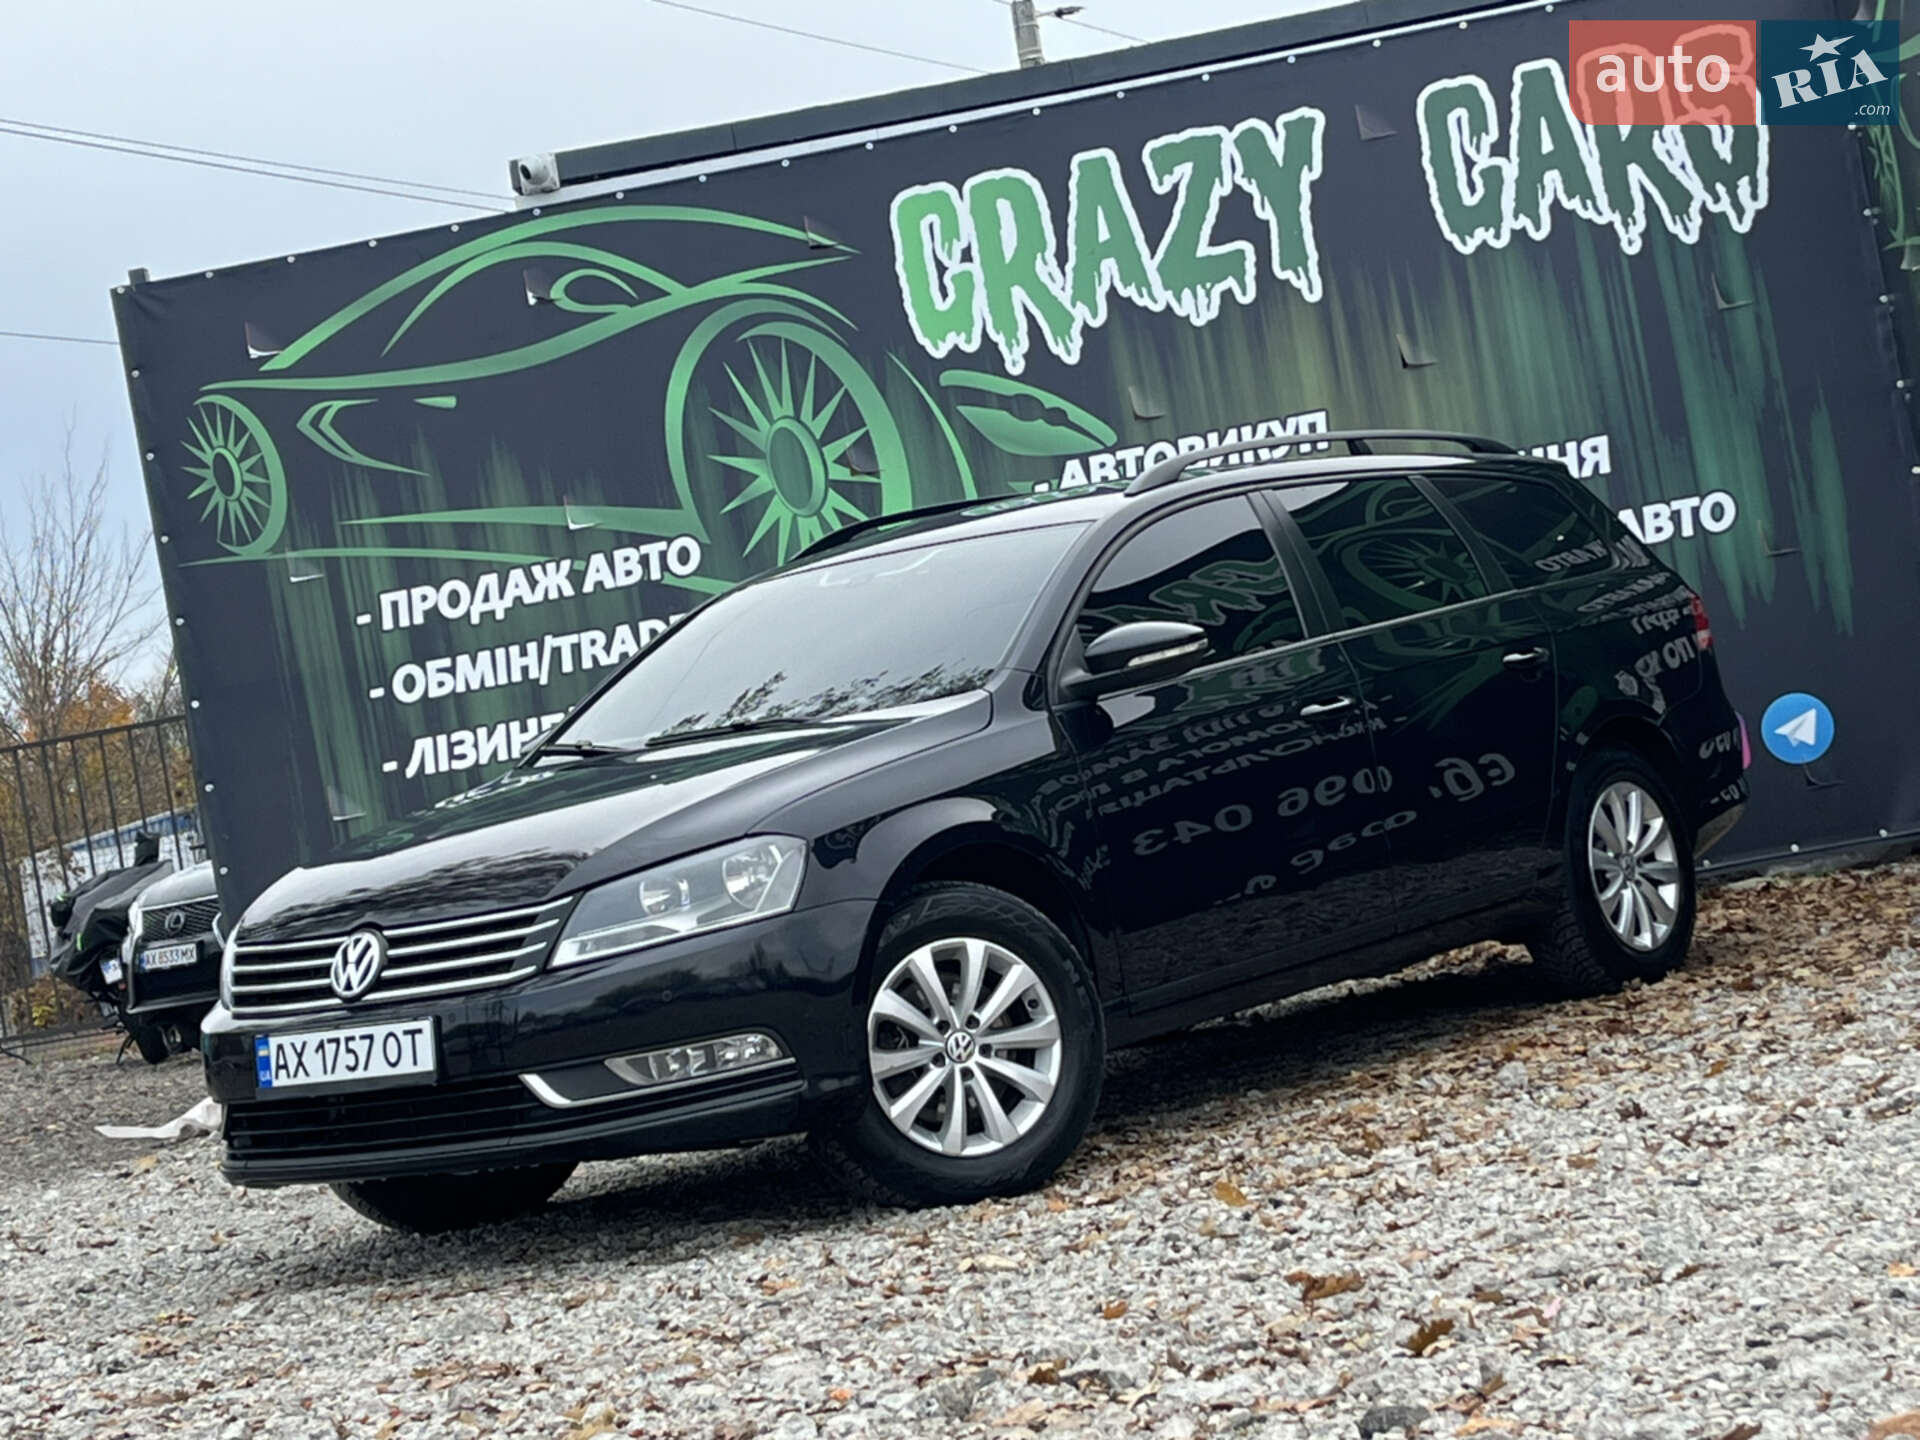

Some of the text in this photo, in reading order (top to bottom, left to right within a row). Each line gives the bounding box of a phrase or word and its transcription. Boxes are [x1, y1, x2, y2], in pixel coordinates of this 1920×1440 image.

[890, 24, 1770, 376] CRAZY CARS
[379, 558, 575, 631] ПРОДАЖ
[582, 536, 702, 594] АВТО
[391, 613, 688, 704] ОБМІН/TRAD
[274, 1038, 310, 1080] AX
[315, 1033, 375, 1075] 1757
[383, 1028, 424, 1069] OT
